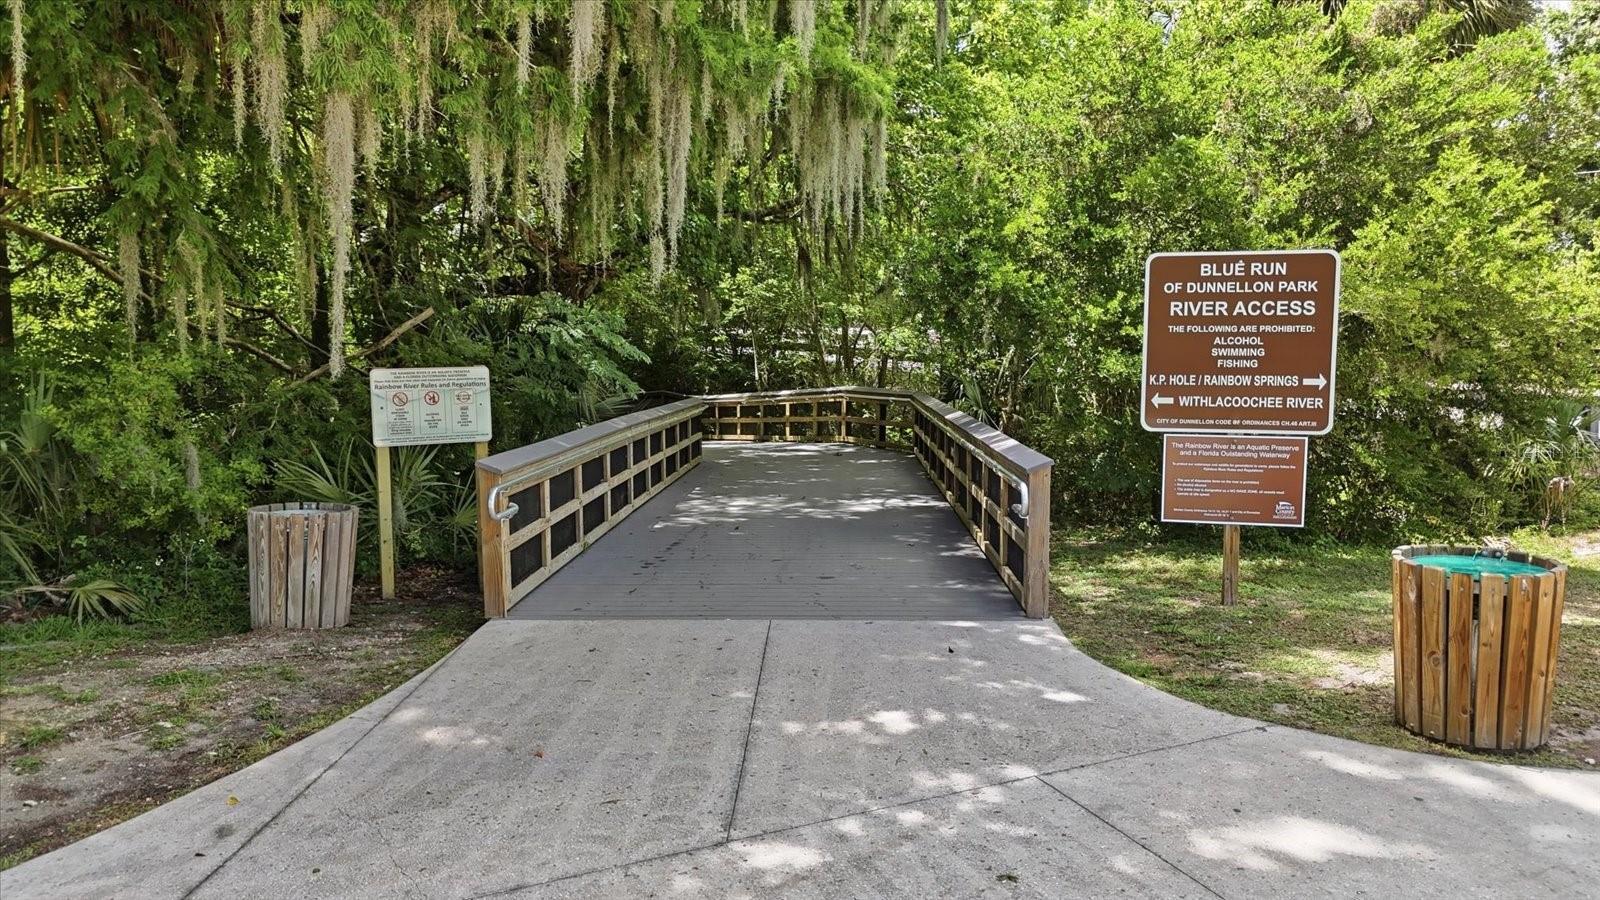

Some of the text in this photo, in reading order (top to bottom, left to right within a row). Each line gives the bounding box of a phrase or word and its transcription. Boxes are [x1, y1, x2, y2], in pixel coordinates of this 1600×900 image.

[1200, 262, 1286, 276] BLUE RUN
[1164, 280, 1318, 294] OF DUNNELLON PARK
[1170, 300, 1316, 316] RIVER ACCESS
[1214, 337, 1263, 345] ALCOHOL
[1211, 348, 1265, 356] SWIMMING
[1150, 375, 1167, 385] K.P.
[1170, 375, 1196, 386] HOLE
[1204, 375, 1251, 386] RAINBOW
[1254, 376, 1299, 386] SPRINGS
[1179, 396, 1323, 408] WITHLACOOCHEE RIVER
